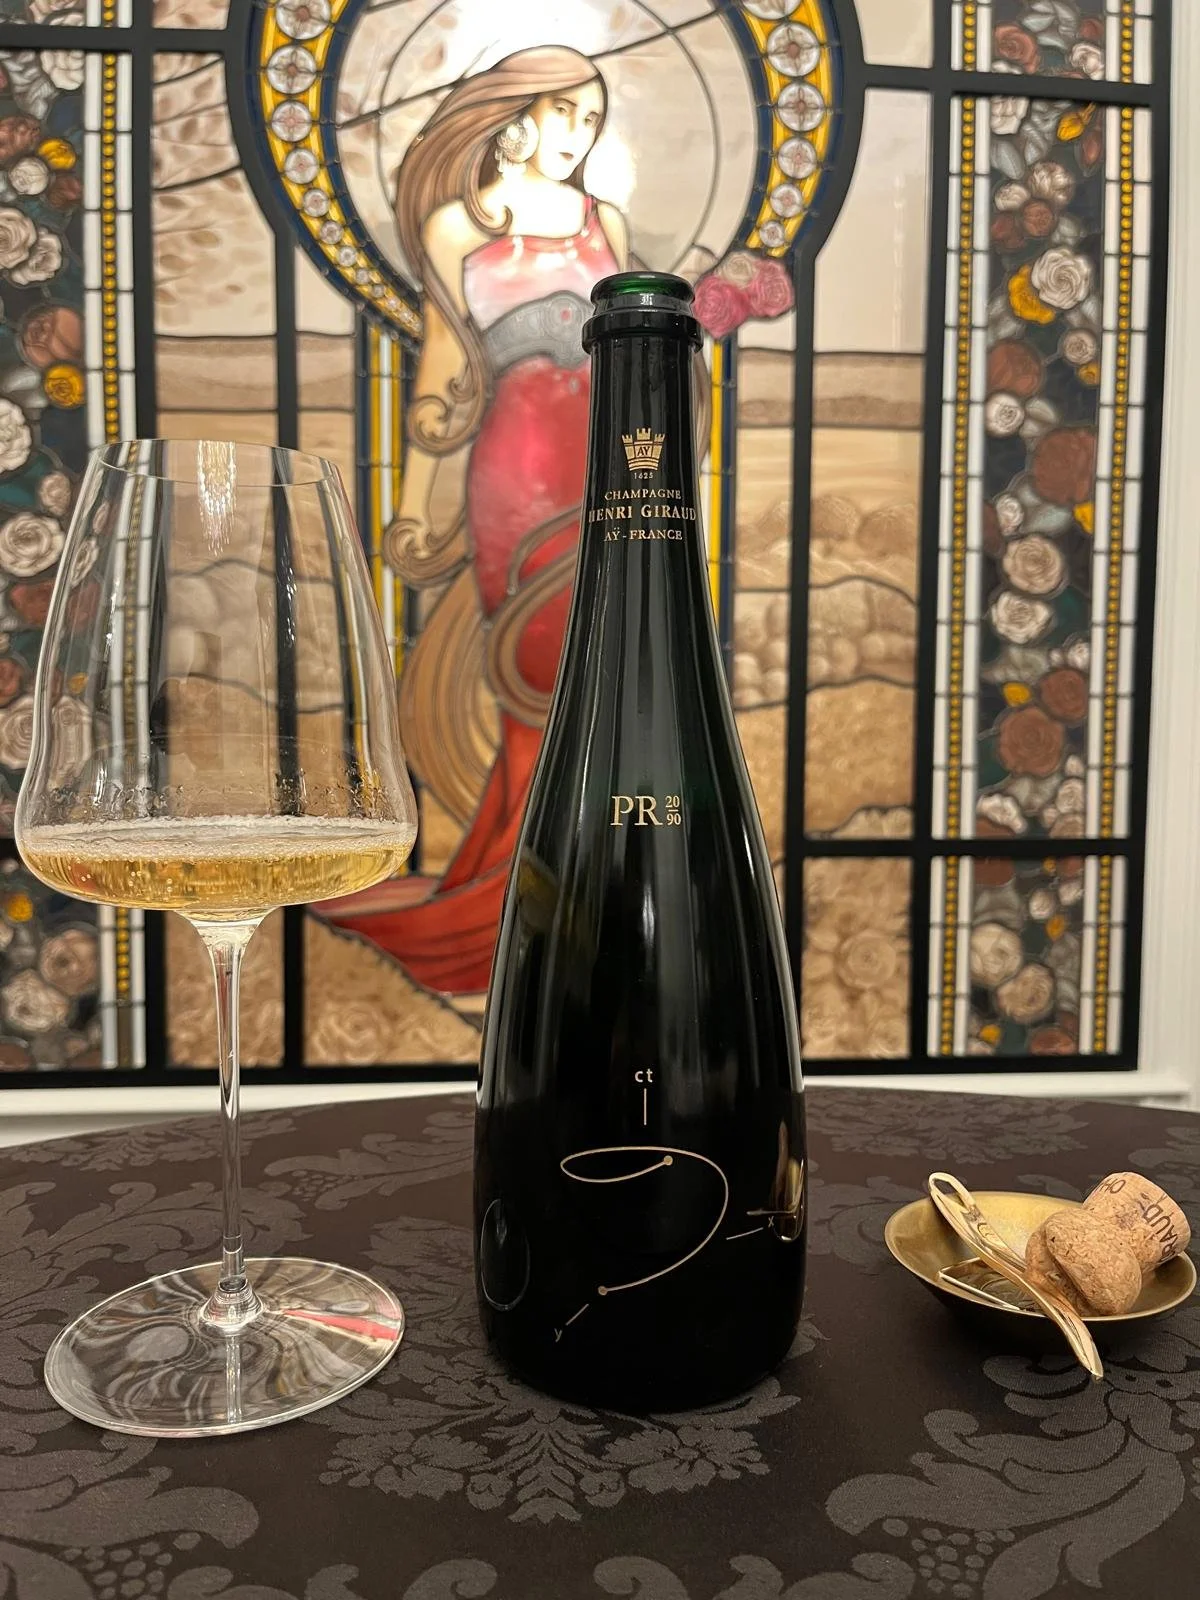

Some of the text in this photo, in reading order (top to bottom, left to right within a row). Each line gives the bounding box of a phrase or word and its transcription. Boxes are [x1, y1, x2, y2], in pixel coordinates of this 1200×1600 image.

[634, 472, 654, 480] 1625
[604, 488, 682, 501] CHAMPAGNE
[588, 504, 697, 523] HENRI GIRAUD
[610, 795, 681, 826] PR 20
[666, 813, 682, 826] 90
[634, 1068, 654, 1083] ct
[552, 1325, 563, 1343] y
